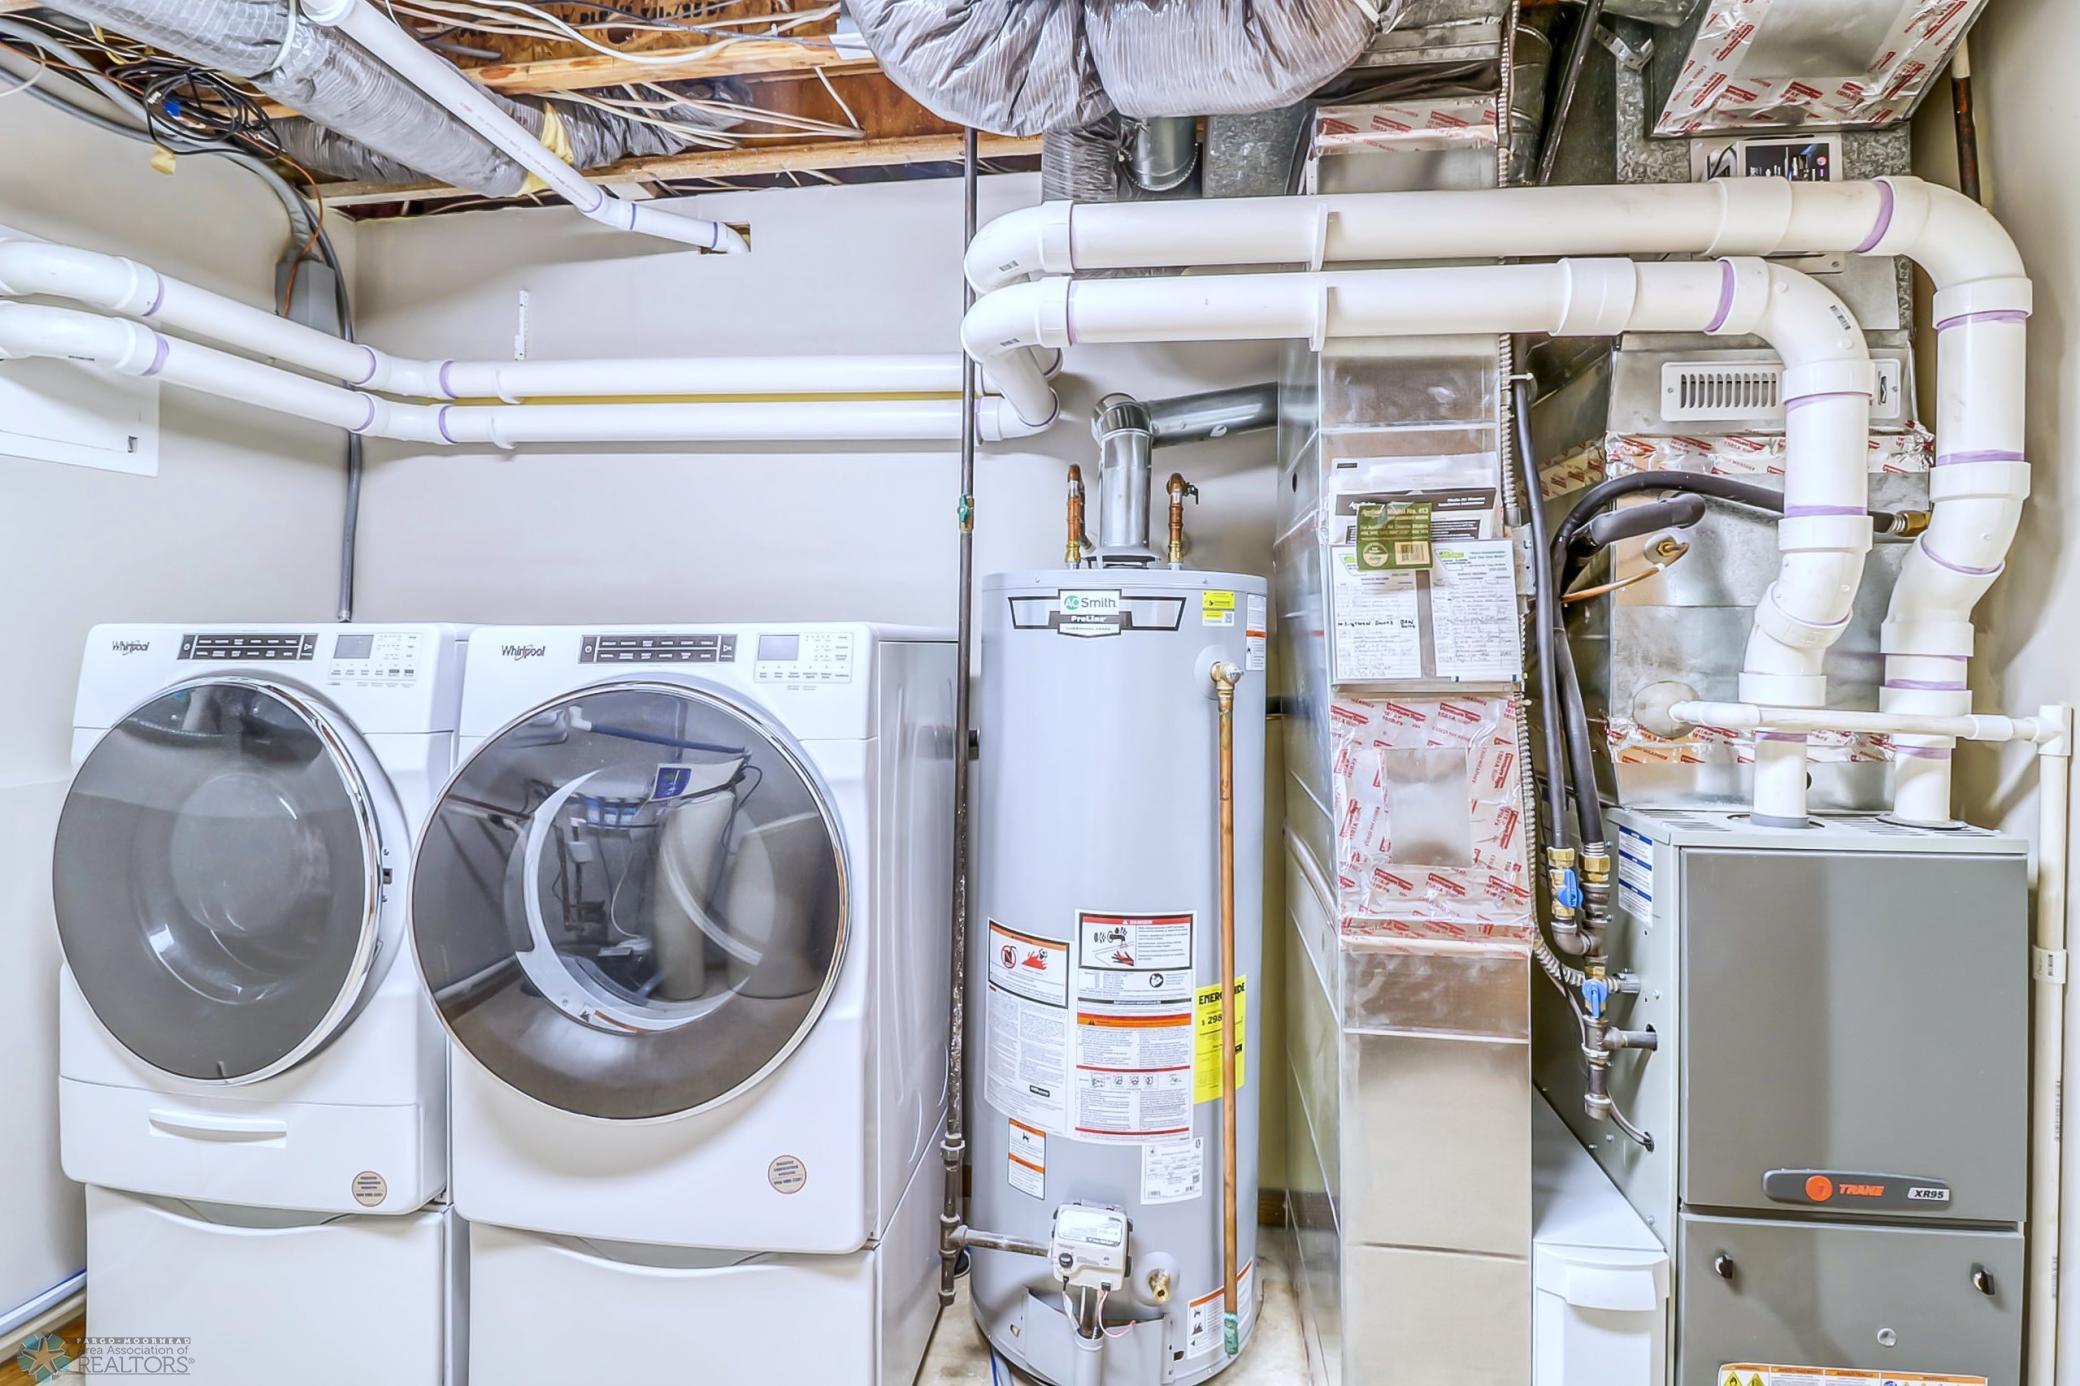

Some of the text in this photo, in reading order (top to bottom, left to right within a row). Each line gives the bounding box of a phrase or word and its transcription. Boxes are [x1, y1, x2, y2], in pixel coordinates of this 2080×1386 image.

[1081, 597, 1116, 608] Smith
[112, 640, 150, 655] Whirlpool
[501, 645, 546, 660] Whirlpool
[1839, 1184, 1884, 1197] TRANE
[1914, 1189, 1944, 1199] XR95
